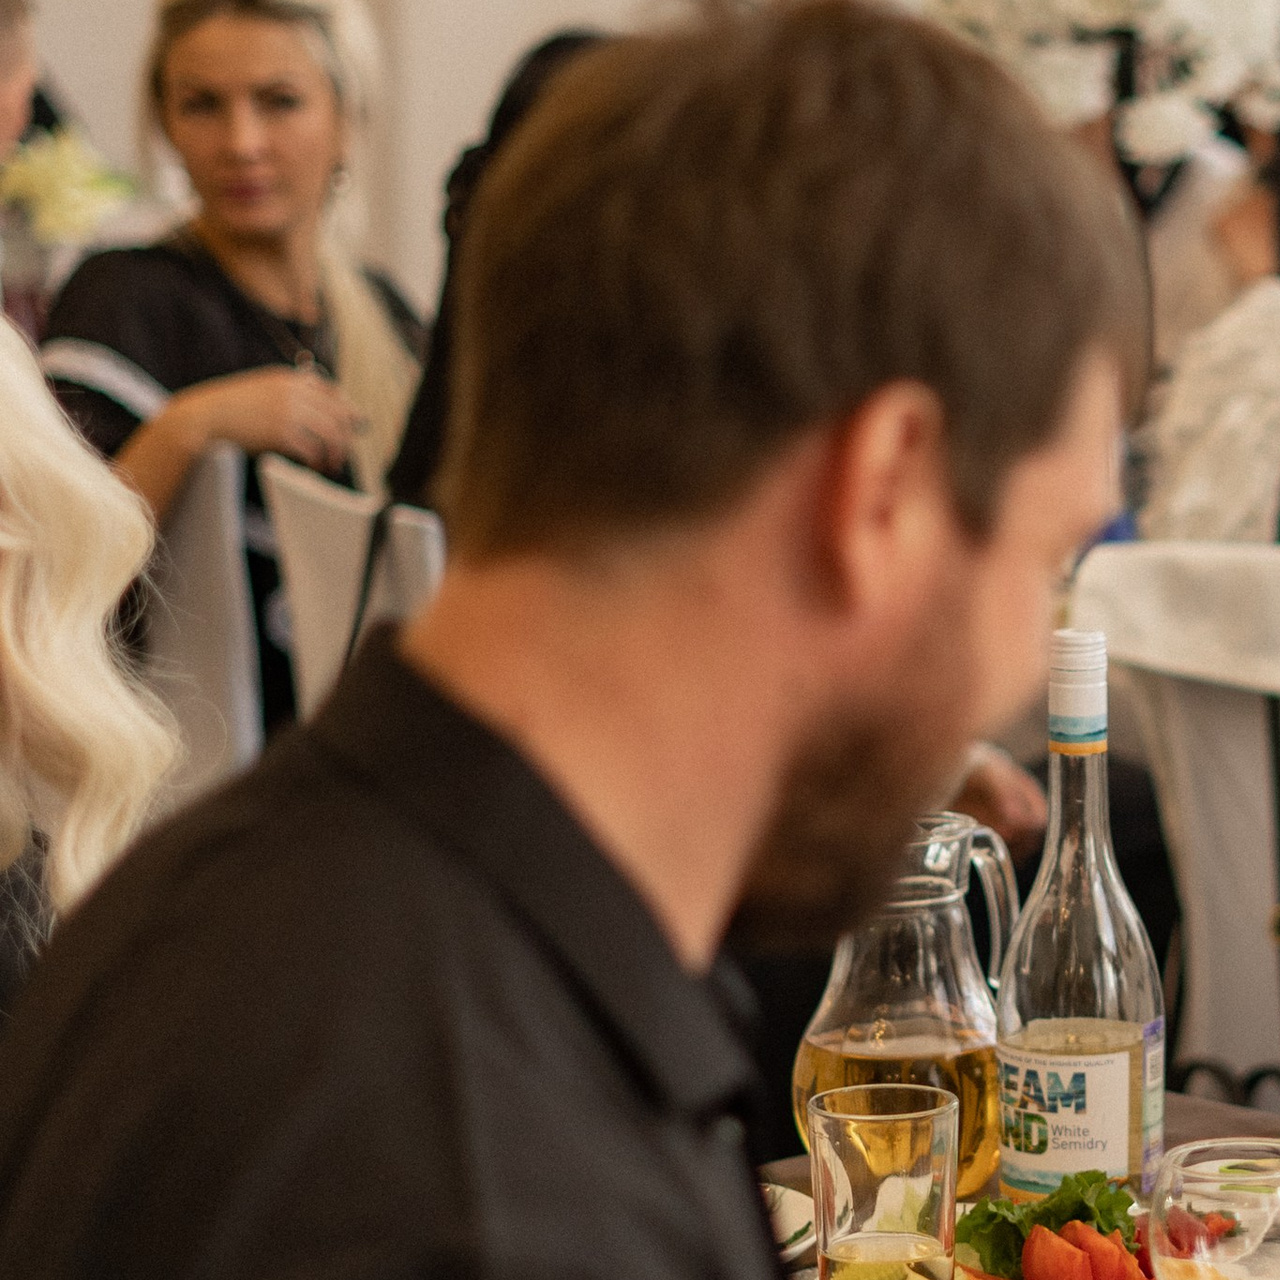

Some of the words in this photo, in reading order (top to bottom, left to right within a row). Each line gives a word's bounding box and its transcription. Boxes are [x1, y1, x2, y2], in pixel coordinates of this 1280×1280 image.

[1083, 1059, 1115, 1067] QUALITY
[999, 1062, 1087, 1115] EAM
[999, 1104, 1049, 1155] ND
[1051, 1124, 1090, 1137] White
[1051, 1137, 1108, 1151] Semidry
